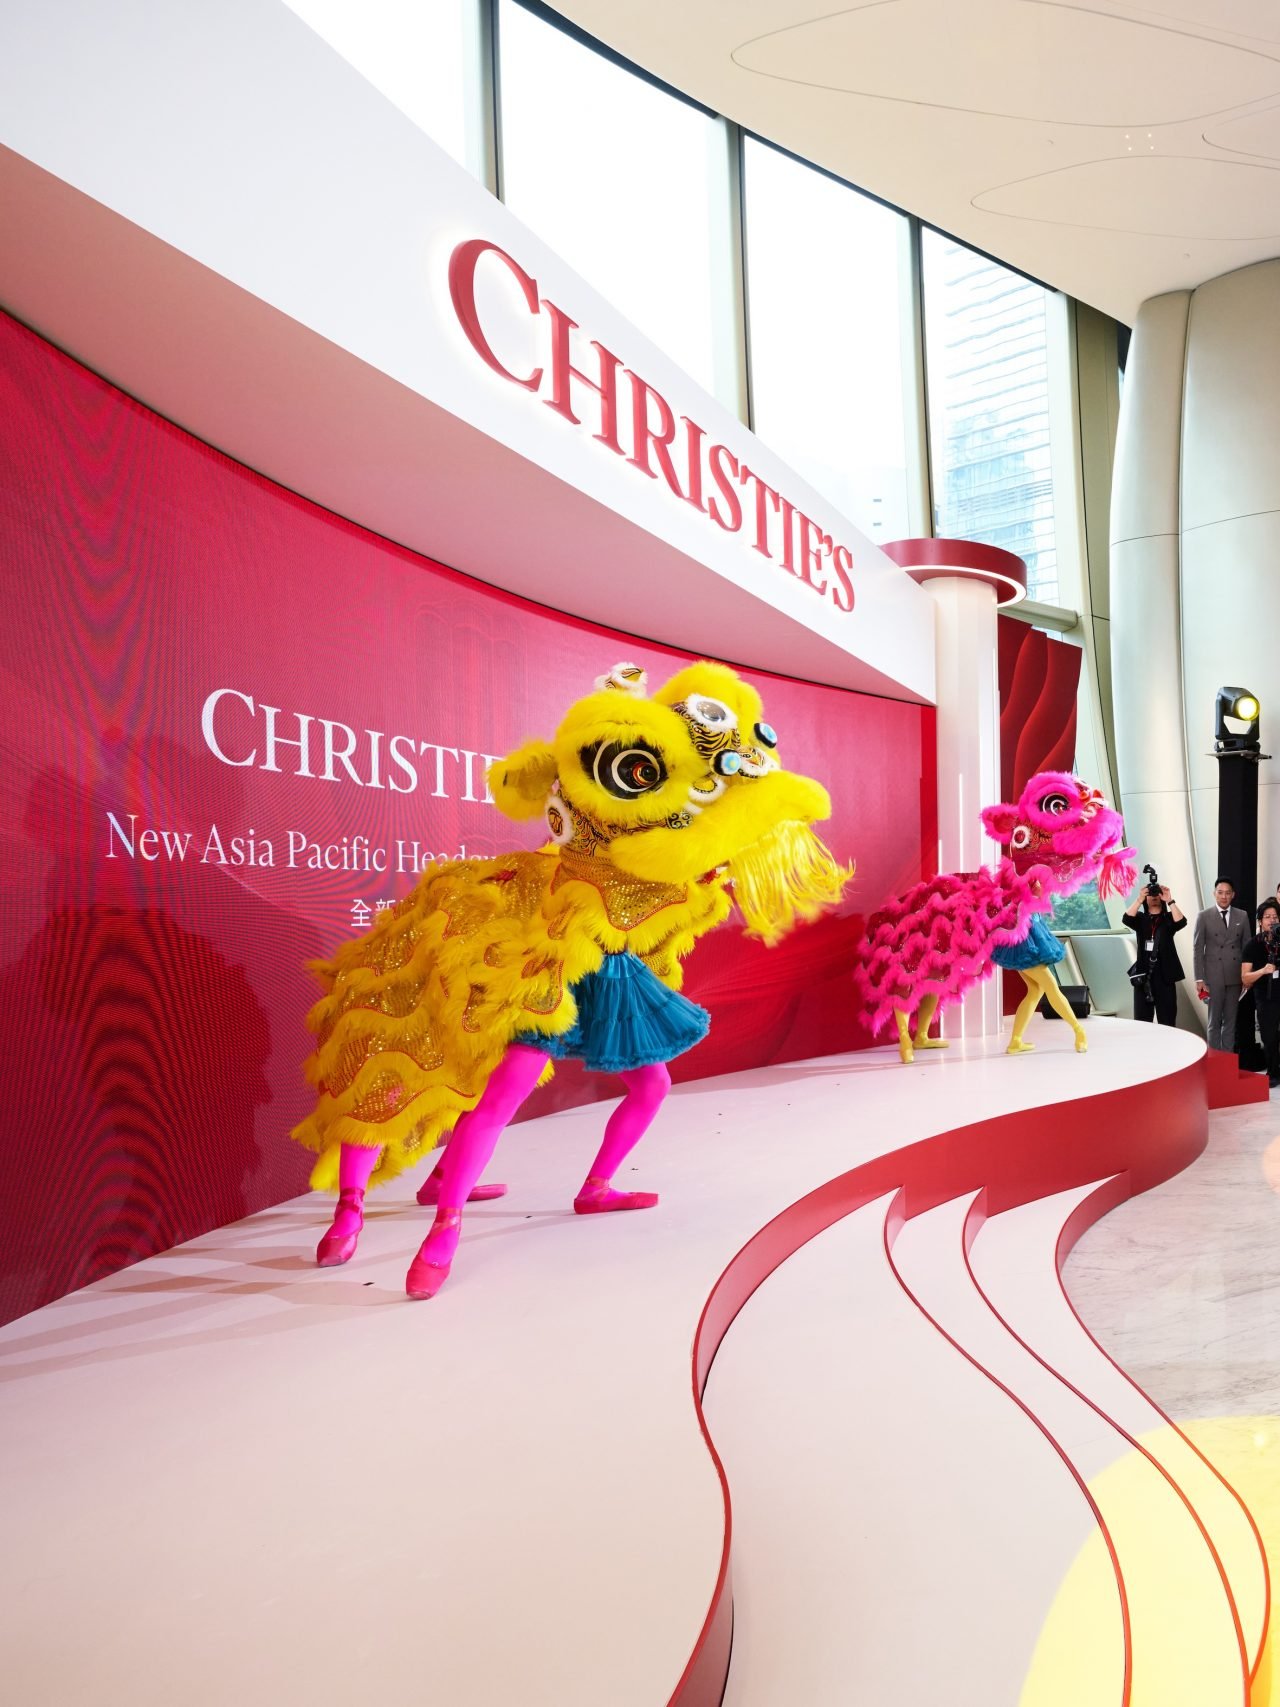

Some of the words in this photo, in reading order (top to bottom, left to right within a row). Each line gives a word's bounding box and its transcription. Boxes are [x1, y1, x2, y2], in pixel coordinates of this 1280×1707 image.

[448, 239, 855, 612] CHRISTIE'S
[105, 811, 193, 861] New
[200, 824, 275, 866] Asia
[286, 830, 387, 872] Pacific
[395, 839, 497, 873] Hed
